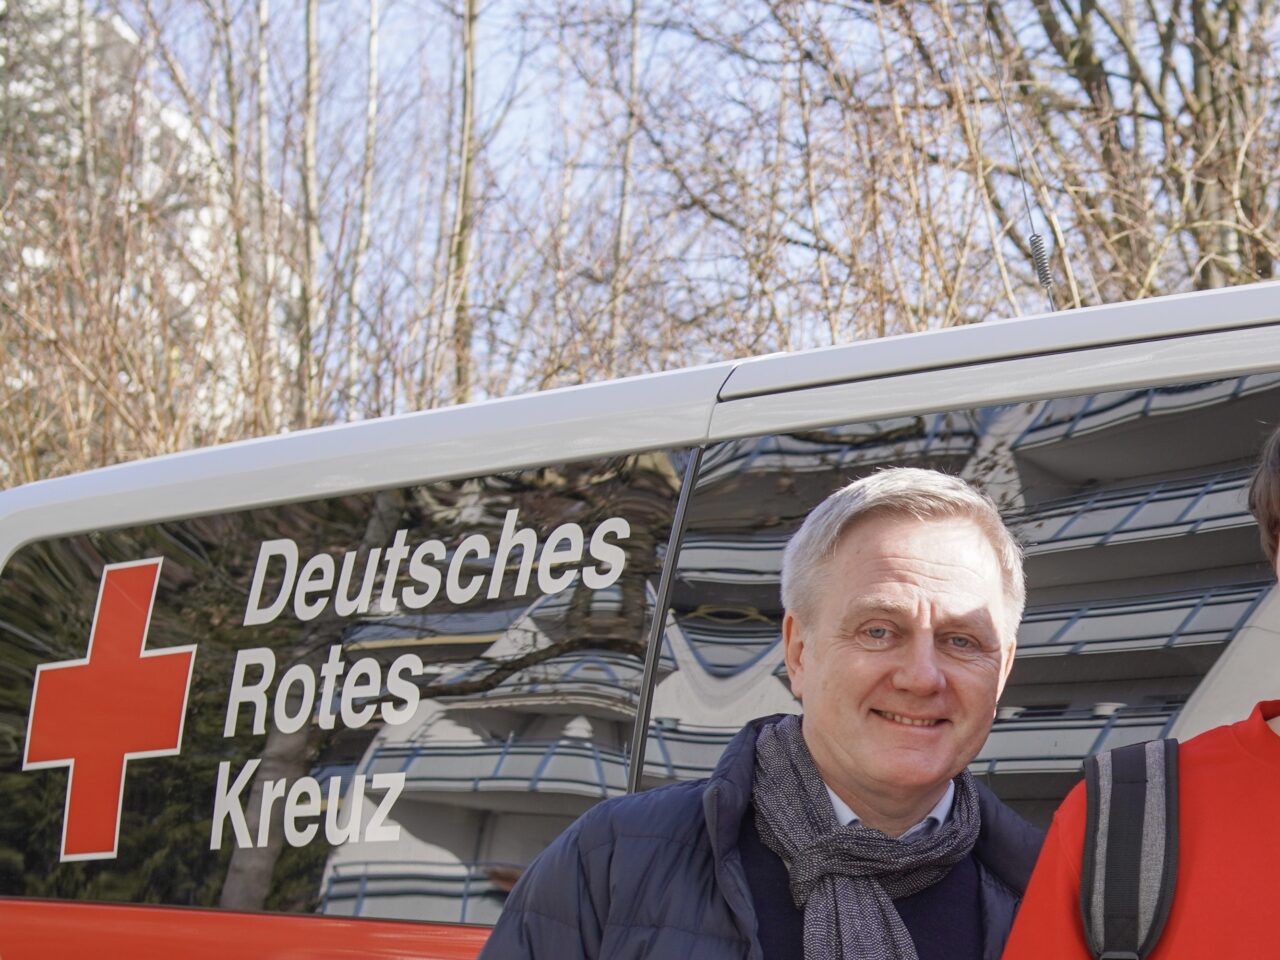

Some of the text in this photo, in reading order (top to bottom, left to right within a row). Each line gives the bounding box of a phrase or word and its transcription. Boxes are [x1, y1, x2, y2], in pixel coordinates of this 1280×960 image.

[243, 509, 631, 626] Deutsches
[223, 645, 424, 737] Rotes
[210, 758, 406, 851] Kreuz
